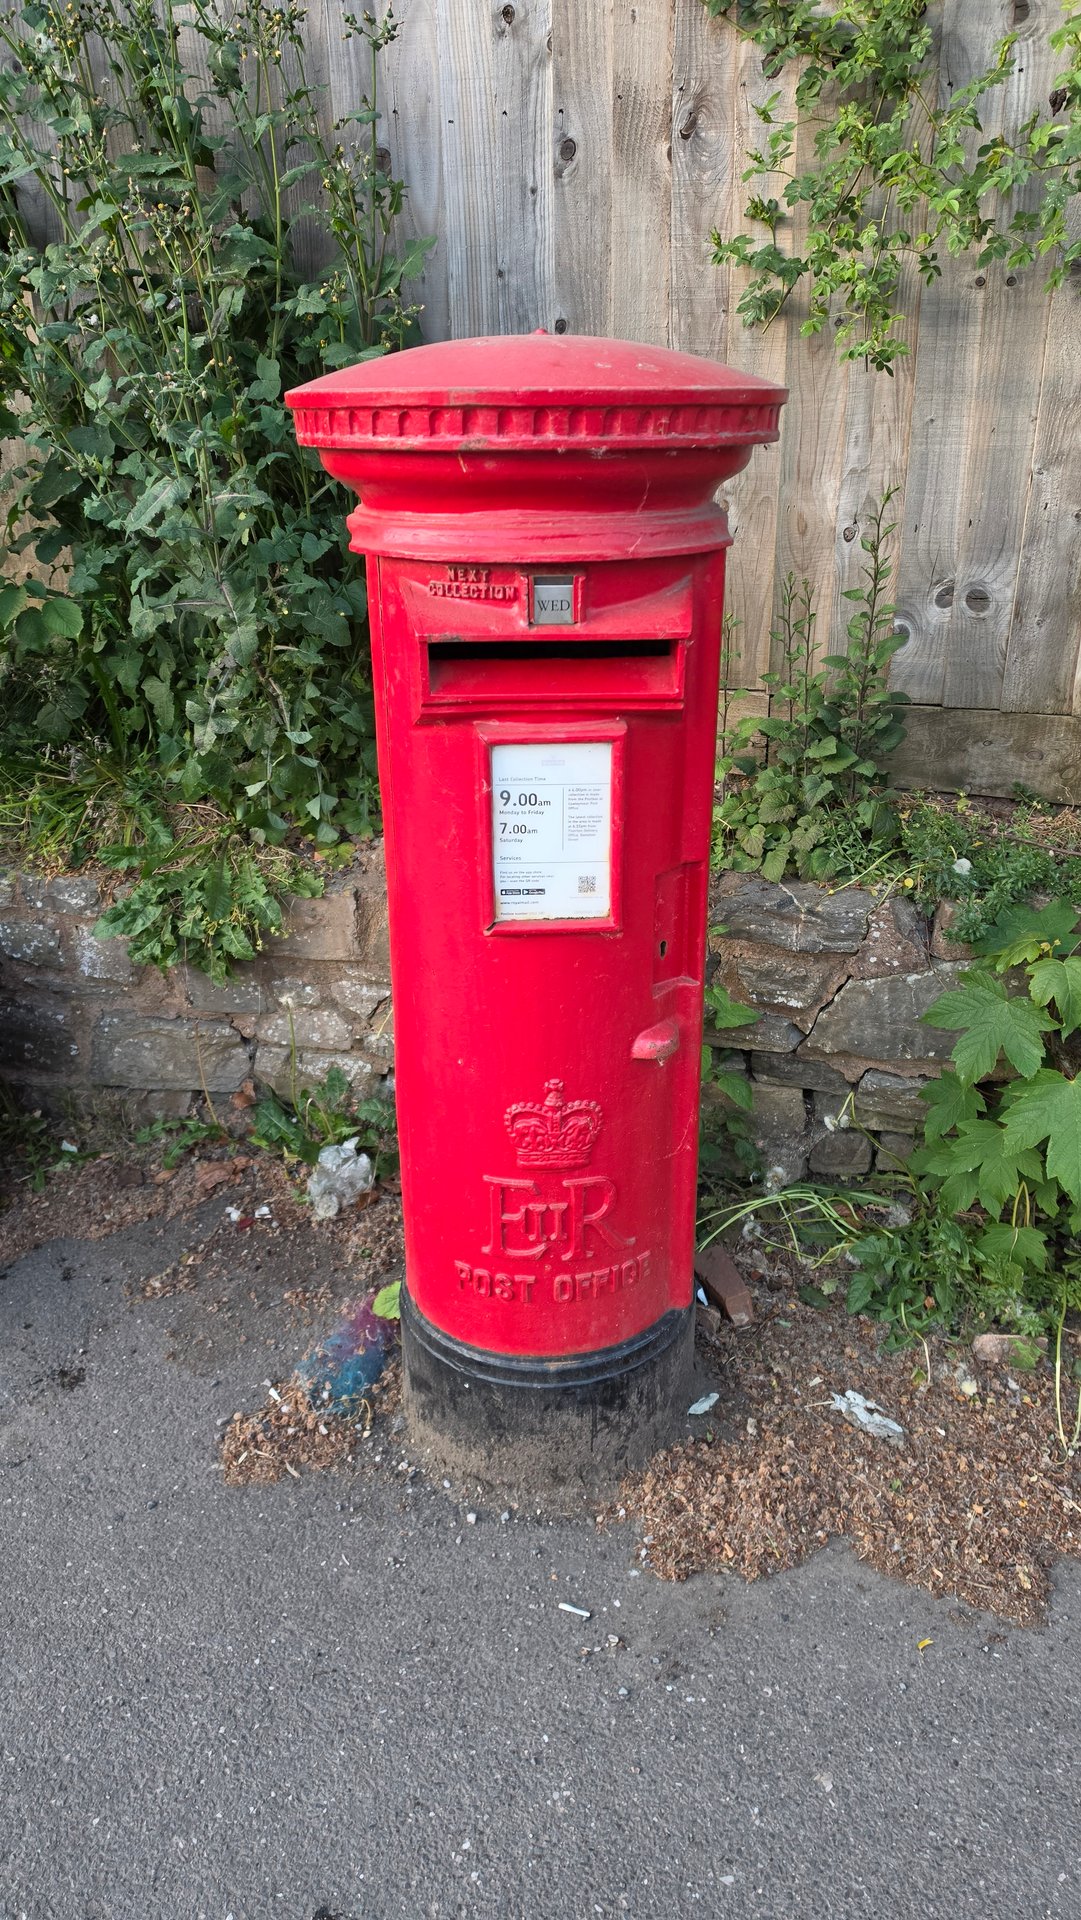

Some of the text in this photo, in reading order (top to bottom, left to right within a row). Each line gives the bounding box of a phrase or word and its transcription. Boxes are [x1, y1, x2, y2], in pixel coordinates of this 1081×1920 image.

[447, 567, 489, 582] NEXT
[428, 580, 516, 600] COLLECTION
[537, 599, 571, 612] WED
[499, 789, 551, 807] 9.00am
[499, 822, 538, 835] 7.00am
[454, 1249, 652, 1303] POST OFFICE
